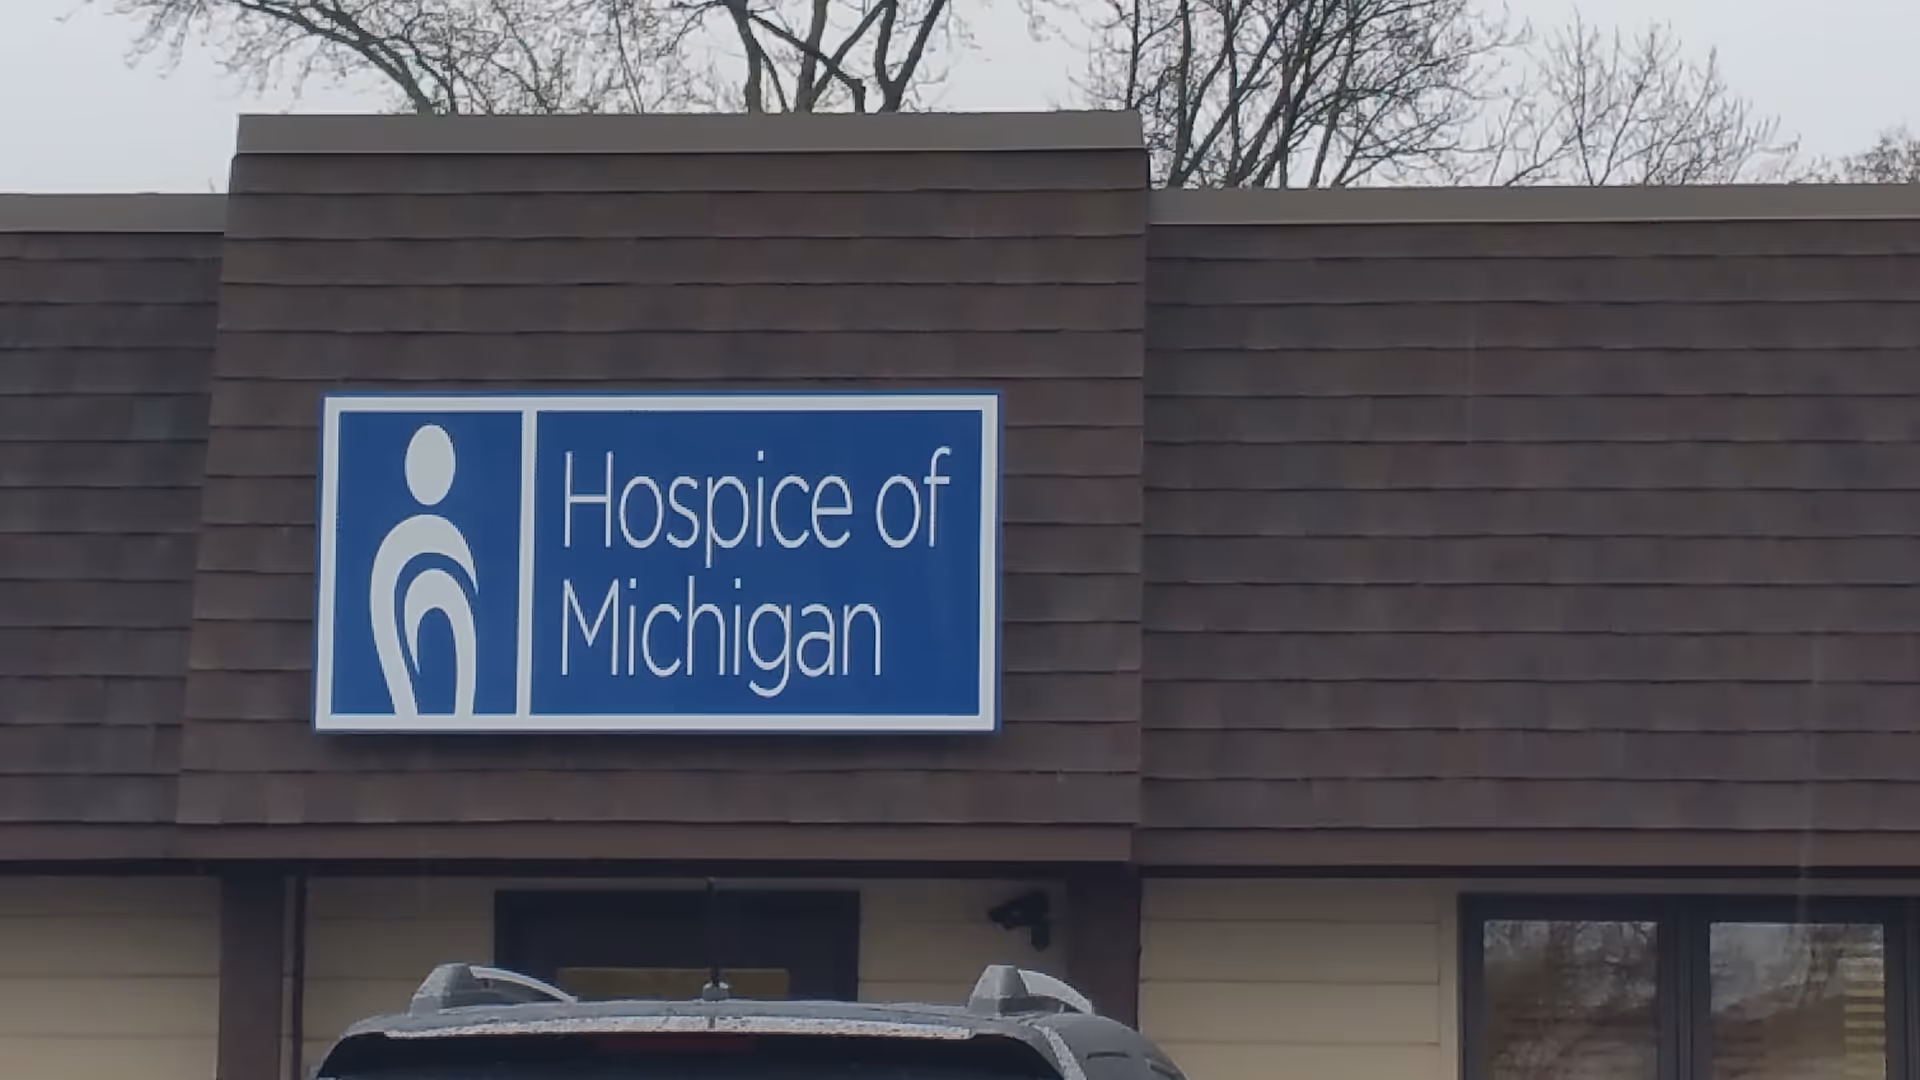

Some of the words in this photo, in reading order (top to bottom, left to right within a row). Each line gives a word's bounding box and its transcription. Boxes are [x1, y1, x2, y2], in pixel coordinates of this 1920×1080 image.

[563, 450, 853, 569] Hospice
[876, 446, 950, 549] of
[561, 575, 882, 698] Michigan
